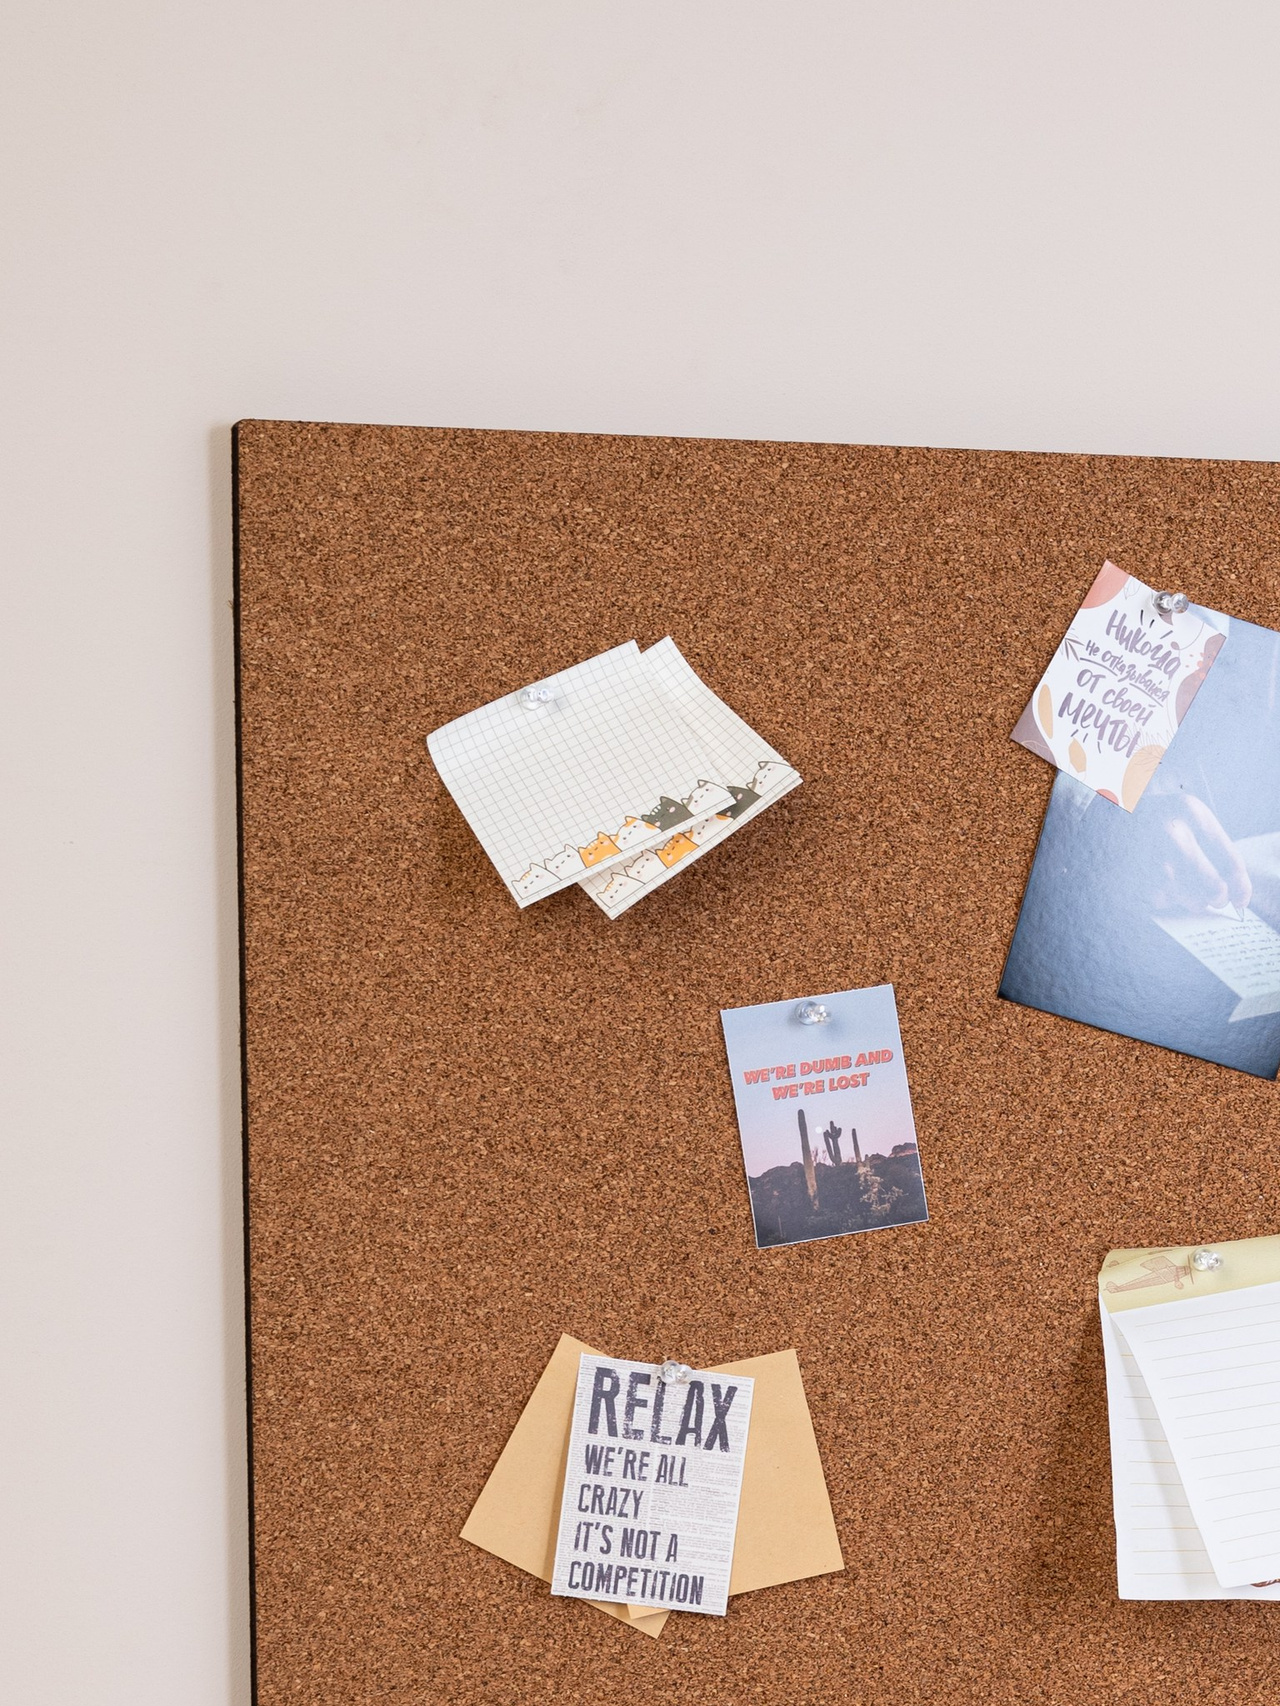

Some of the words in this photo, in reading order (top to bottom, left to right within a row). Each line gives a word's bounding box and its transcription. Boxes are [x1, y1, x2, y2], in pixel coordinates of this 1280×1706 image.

[1105, 609, 1181, 680] Никогда
[1102, 687, 1157, 726] своей
[743, 1064, 796, 1085] WE'RE
[800, 1055, 852, 1077] DUMB
[854, 1048, 894, 1068] AND
[771, 1080, 825, 1100] WE'RE
[828, 1072, 870, 1092] LOST
[588, 1366, 738, 1452] RELAX
[584, 1444, 651, 1482] WE'RE
[655, 1454, 690, 1488] ALL
[577, 1483, 644, 1520] CRAZY
[574, 1521, 614, 1555] IT'S
[620, 1527, 661, 1561] NOT
[665, 1533, 679, 1563] A
[567, 1560, 704, 1606] COMPETITION
